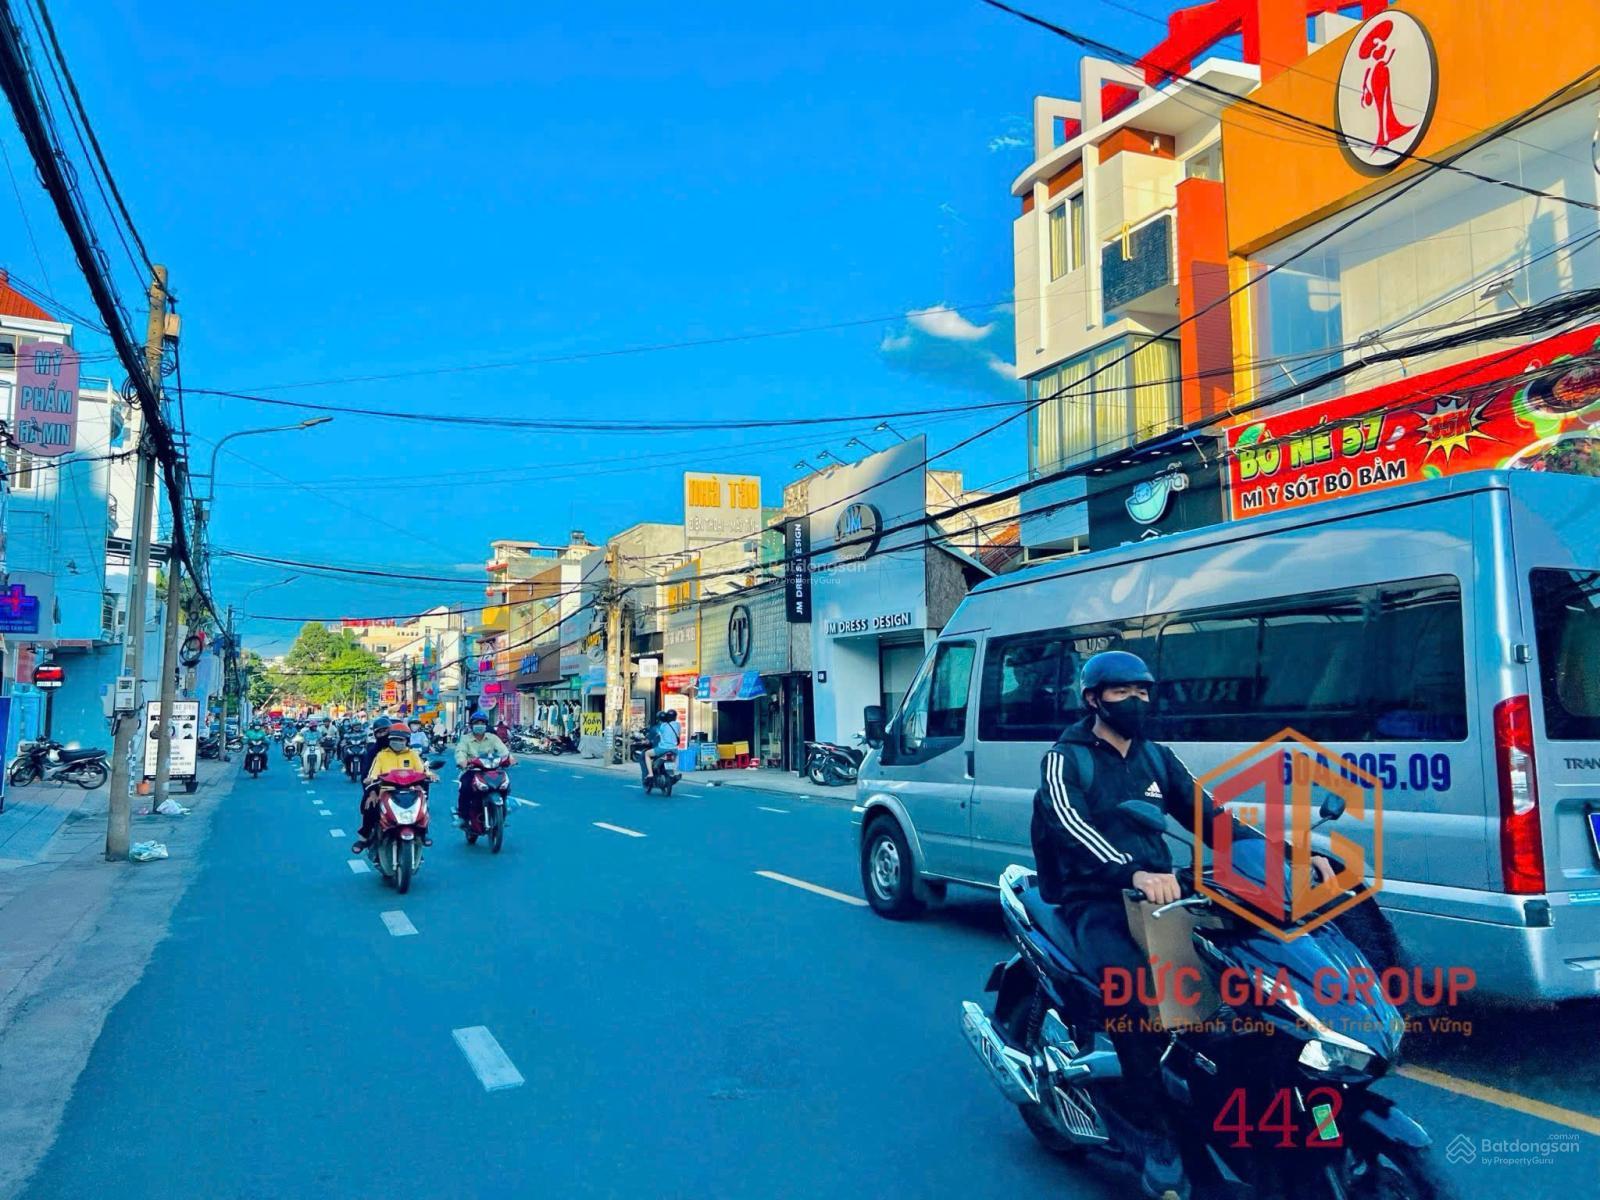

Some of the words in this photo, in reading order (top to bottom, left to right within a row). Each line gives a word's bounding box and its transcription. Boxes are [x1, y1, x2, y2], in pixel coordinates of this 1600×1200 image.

[35, 348, 64, 376] MỸ
[42, 422, 72, 446] MIN
[1290, 415, 1334, 468] NÉ
[1342, 415, 1386, 456] 57
[1268, 483, 1279, 503] Ý
[1325, 467, 1352, 492] BÒ
[795, 600, 804, 616] JM
[824, 618, 839, 636] JM
[838, 615, 868, 634] DRESS
[873, 612, 912, 629] DESIGN
